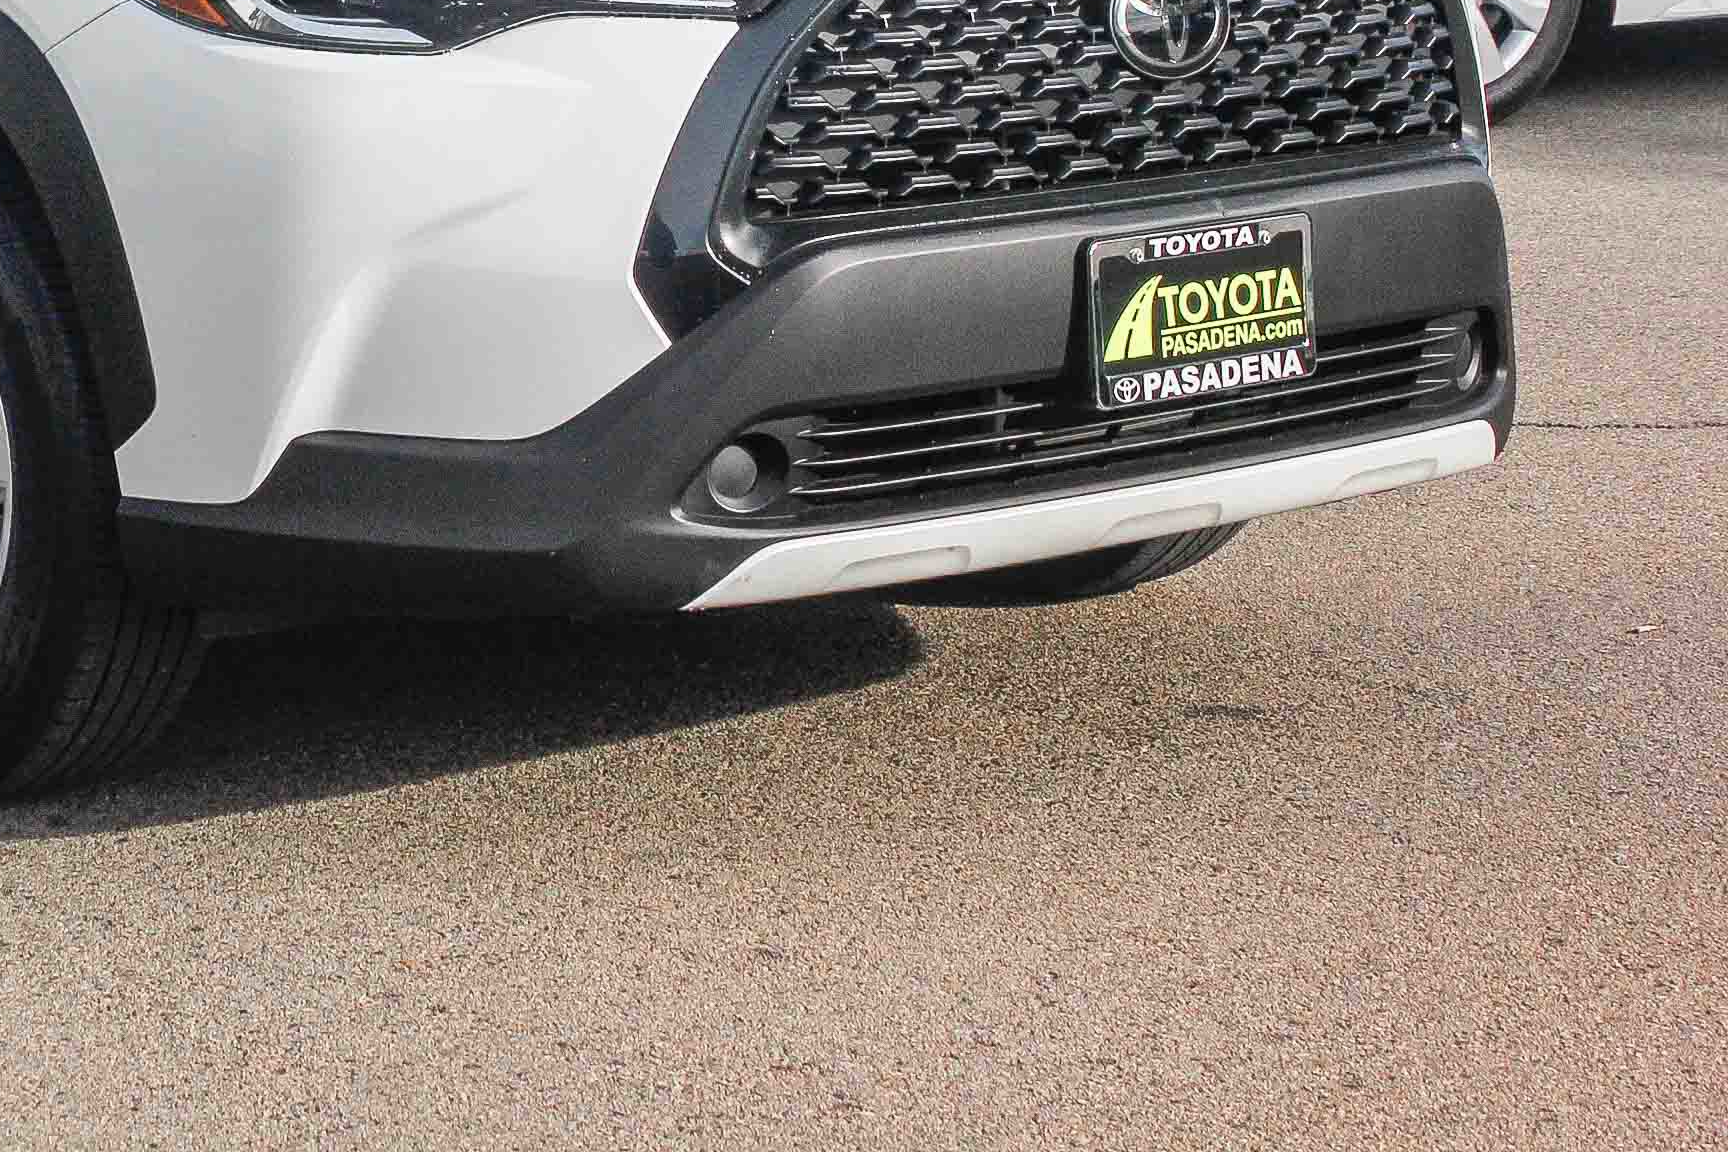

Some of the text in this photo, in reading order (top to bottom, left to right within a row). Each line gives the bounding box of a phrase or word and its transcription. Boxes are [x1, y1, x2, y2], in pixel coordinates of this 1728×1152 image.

[1148, 225, 1256, 258] TOYOTA
[1157, 266, 1302, 328] TOYOTA
[1161, 318, 1304, 359] PASADENA.com
[1143, 349, 1304, 401] PASADENA
